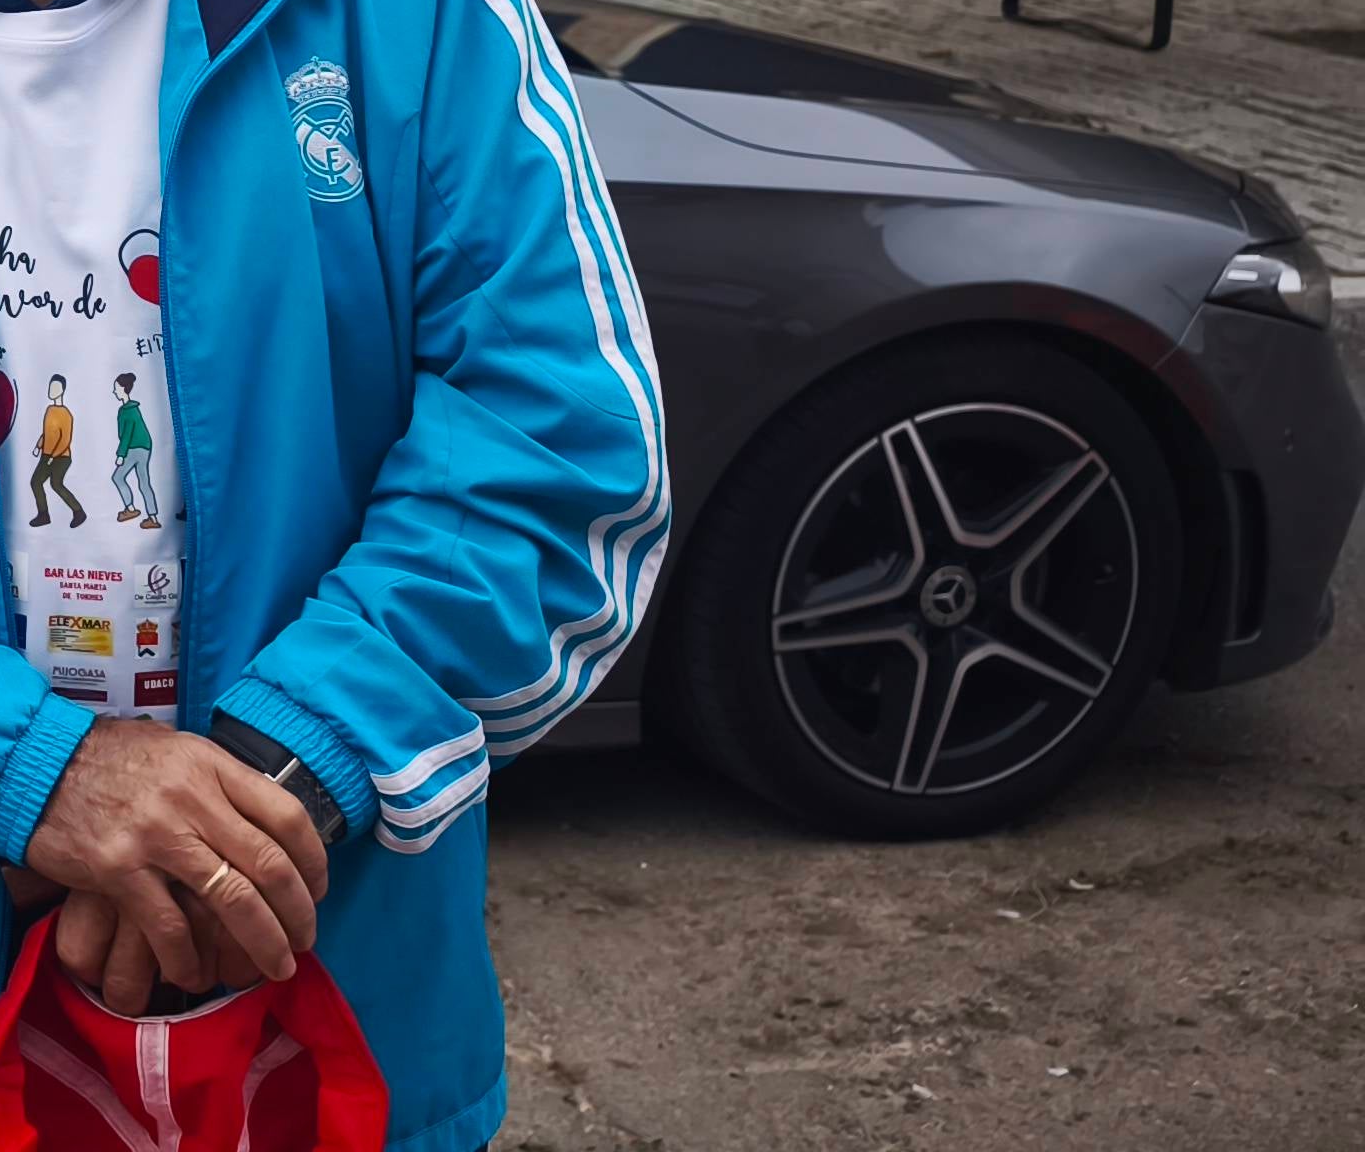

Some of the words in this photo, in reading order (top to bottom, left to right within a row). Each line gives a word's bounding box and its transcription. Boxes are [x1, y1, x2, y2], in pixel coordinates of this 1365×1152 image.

[73, 273, 107, 320] de
[44, 568, 64, 578] BAR
[67, 569, 85, 579] LAS
[87, 570, 123, 582] NIEVES
